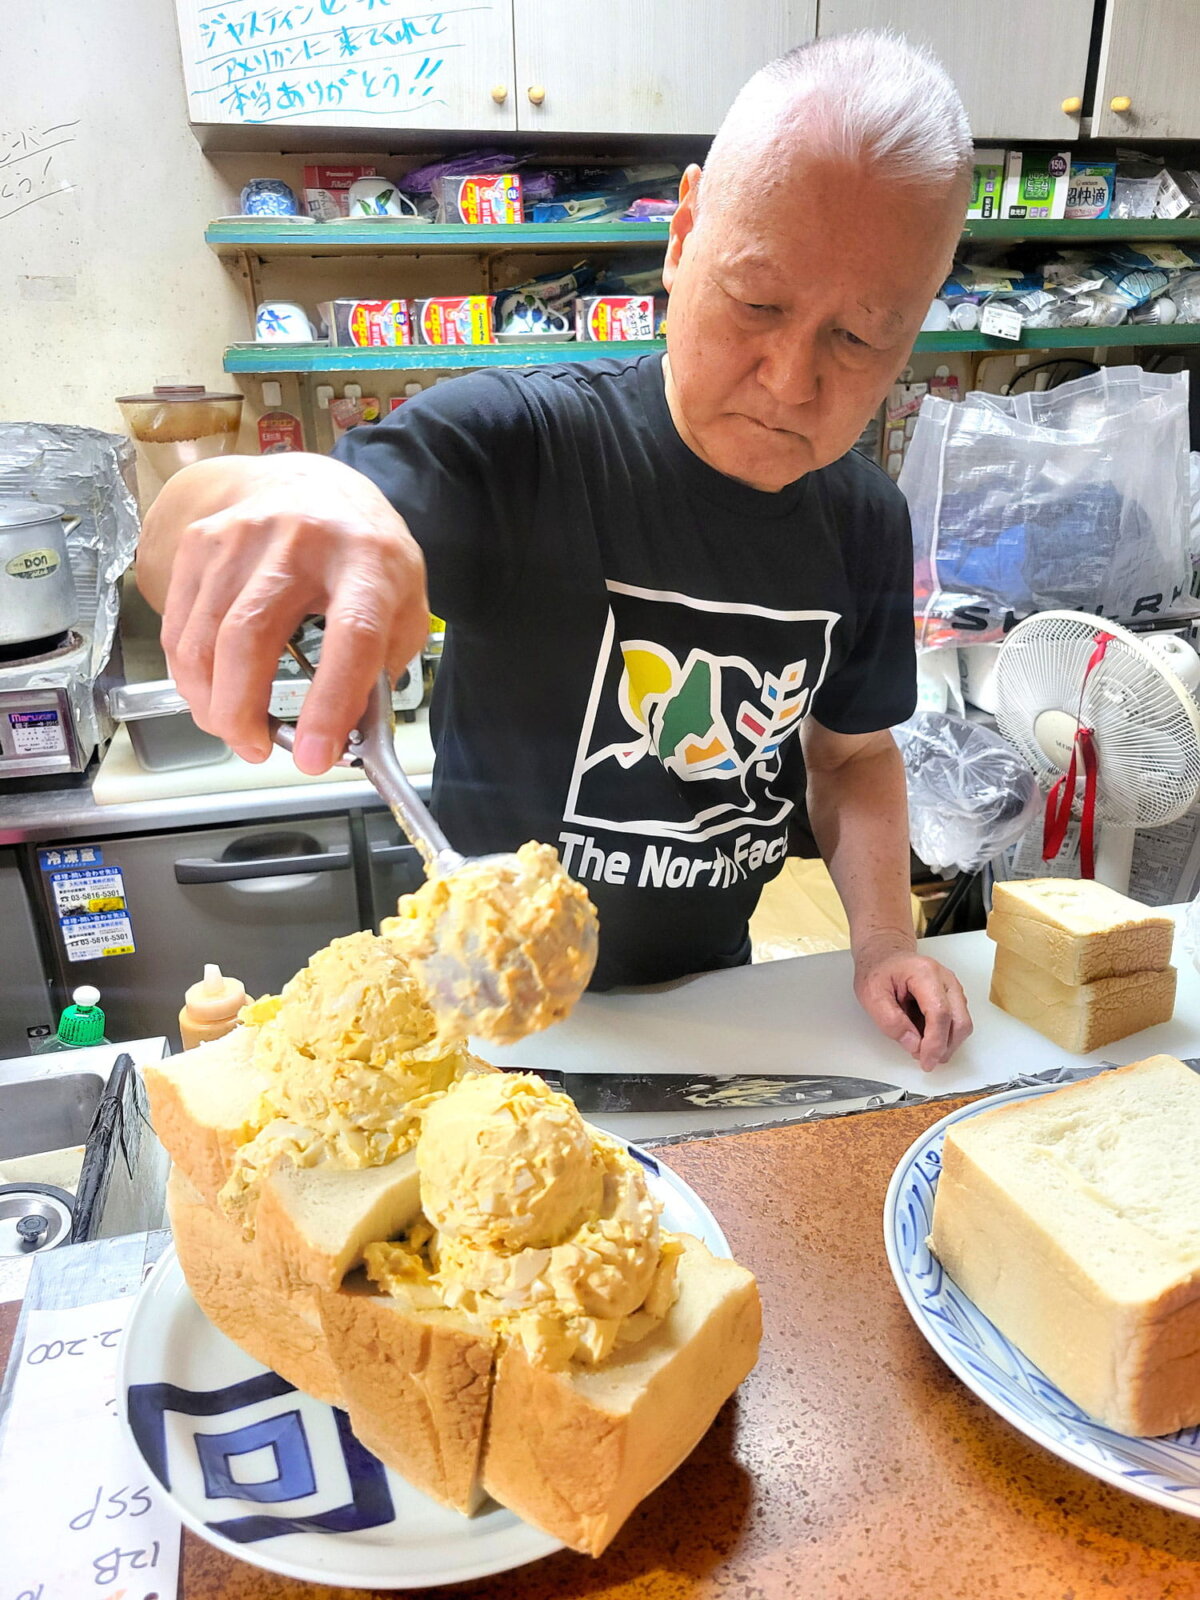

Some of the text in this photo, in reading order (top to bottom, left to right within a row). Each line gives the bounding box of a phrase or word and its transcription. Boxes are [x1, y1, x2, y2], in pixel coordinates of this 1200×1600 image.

[46, 848, 96, 866] 冷凍室
[558, 832, 631, 885] The
[638, 845, 738, 889] North
[71, 890, 120, 902] 03-5816-5301
